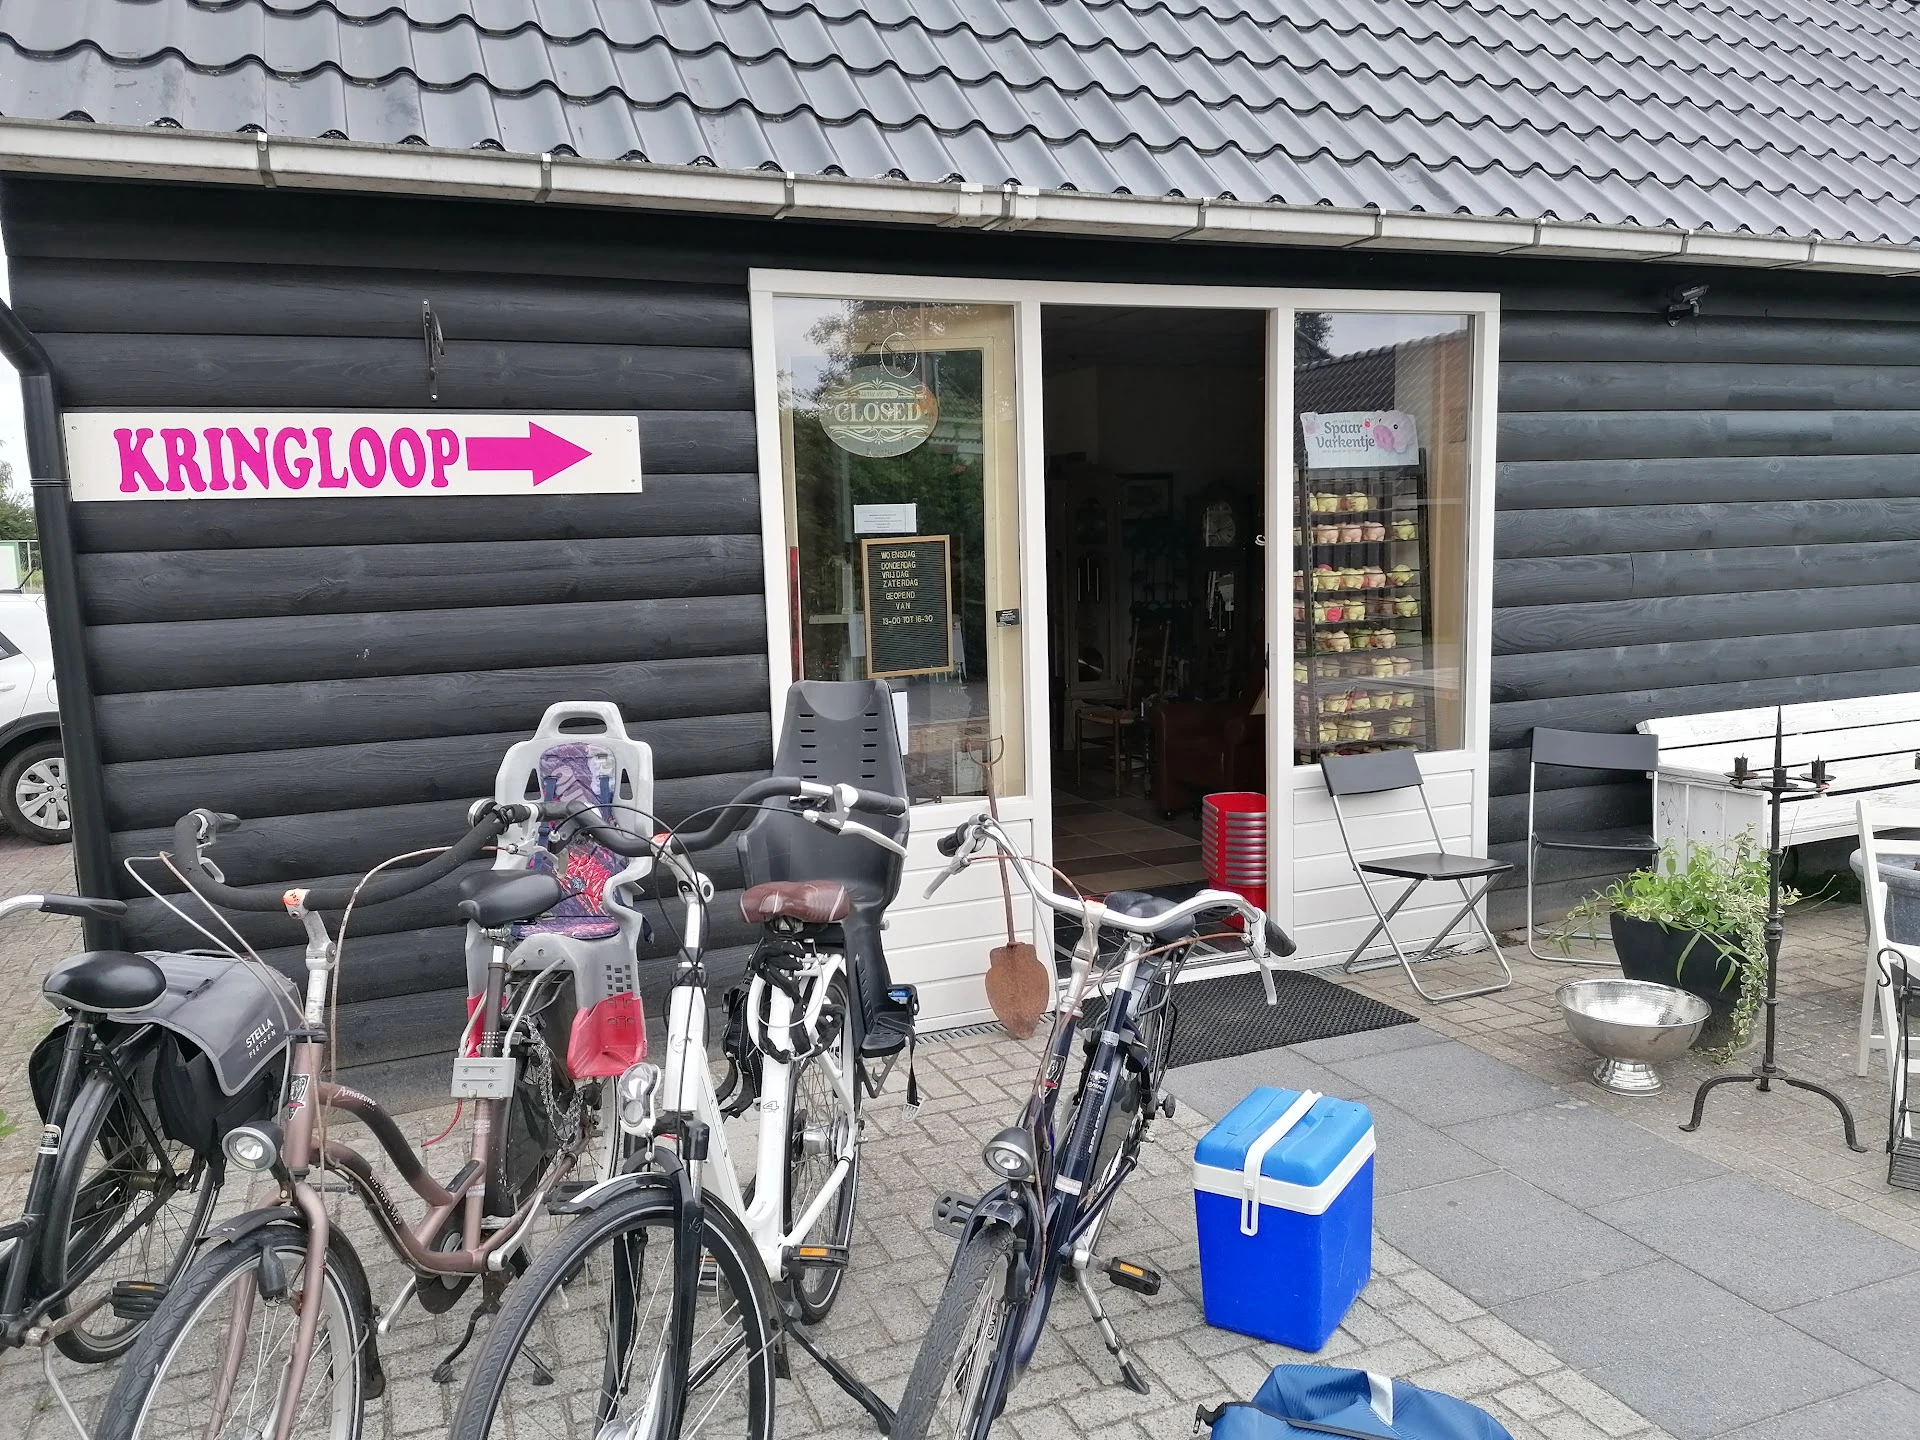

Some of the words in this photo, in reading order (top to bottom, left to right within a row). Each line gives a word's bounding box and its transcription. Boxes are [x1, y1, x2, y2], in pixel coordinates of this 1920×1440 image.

[834, 402, 922, 422] CLOSED
[1324, 421, 1363, 439] Spaar
[1315, 434, 1376, 452] Varkentje
[113, 426, 460, 493] KRINGLOOP
[881, 561, 917, 570] DONDERDAG
[883, 579, 919, 588] ZATERDAG
[885, 591, 916, 600] GEOPEND
[895, 602, 911, 610] VAN
[903, 615, 914, 624] TOT
[245, 1018, 274, 1049] STELLA
[248, 1028, 278, 1060] FIETSEN
